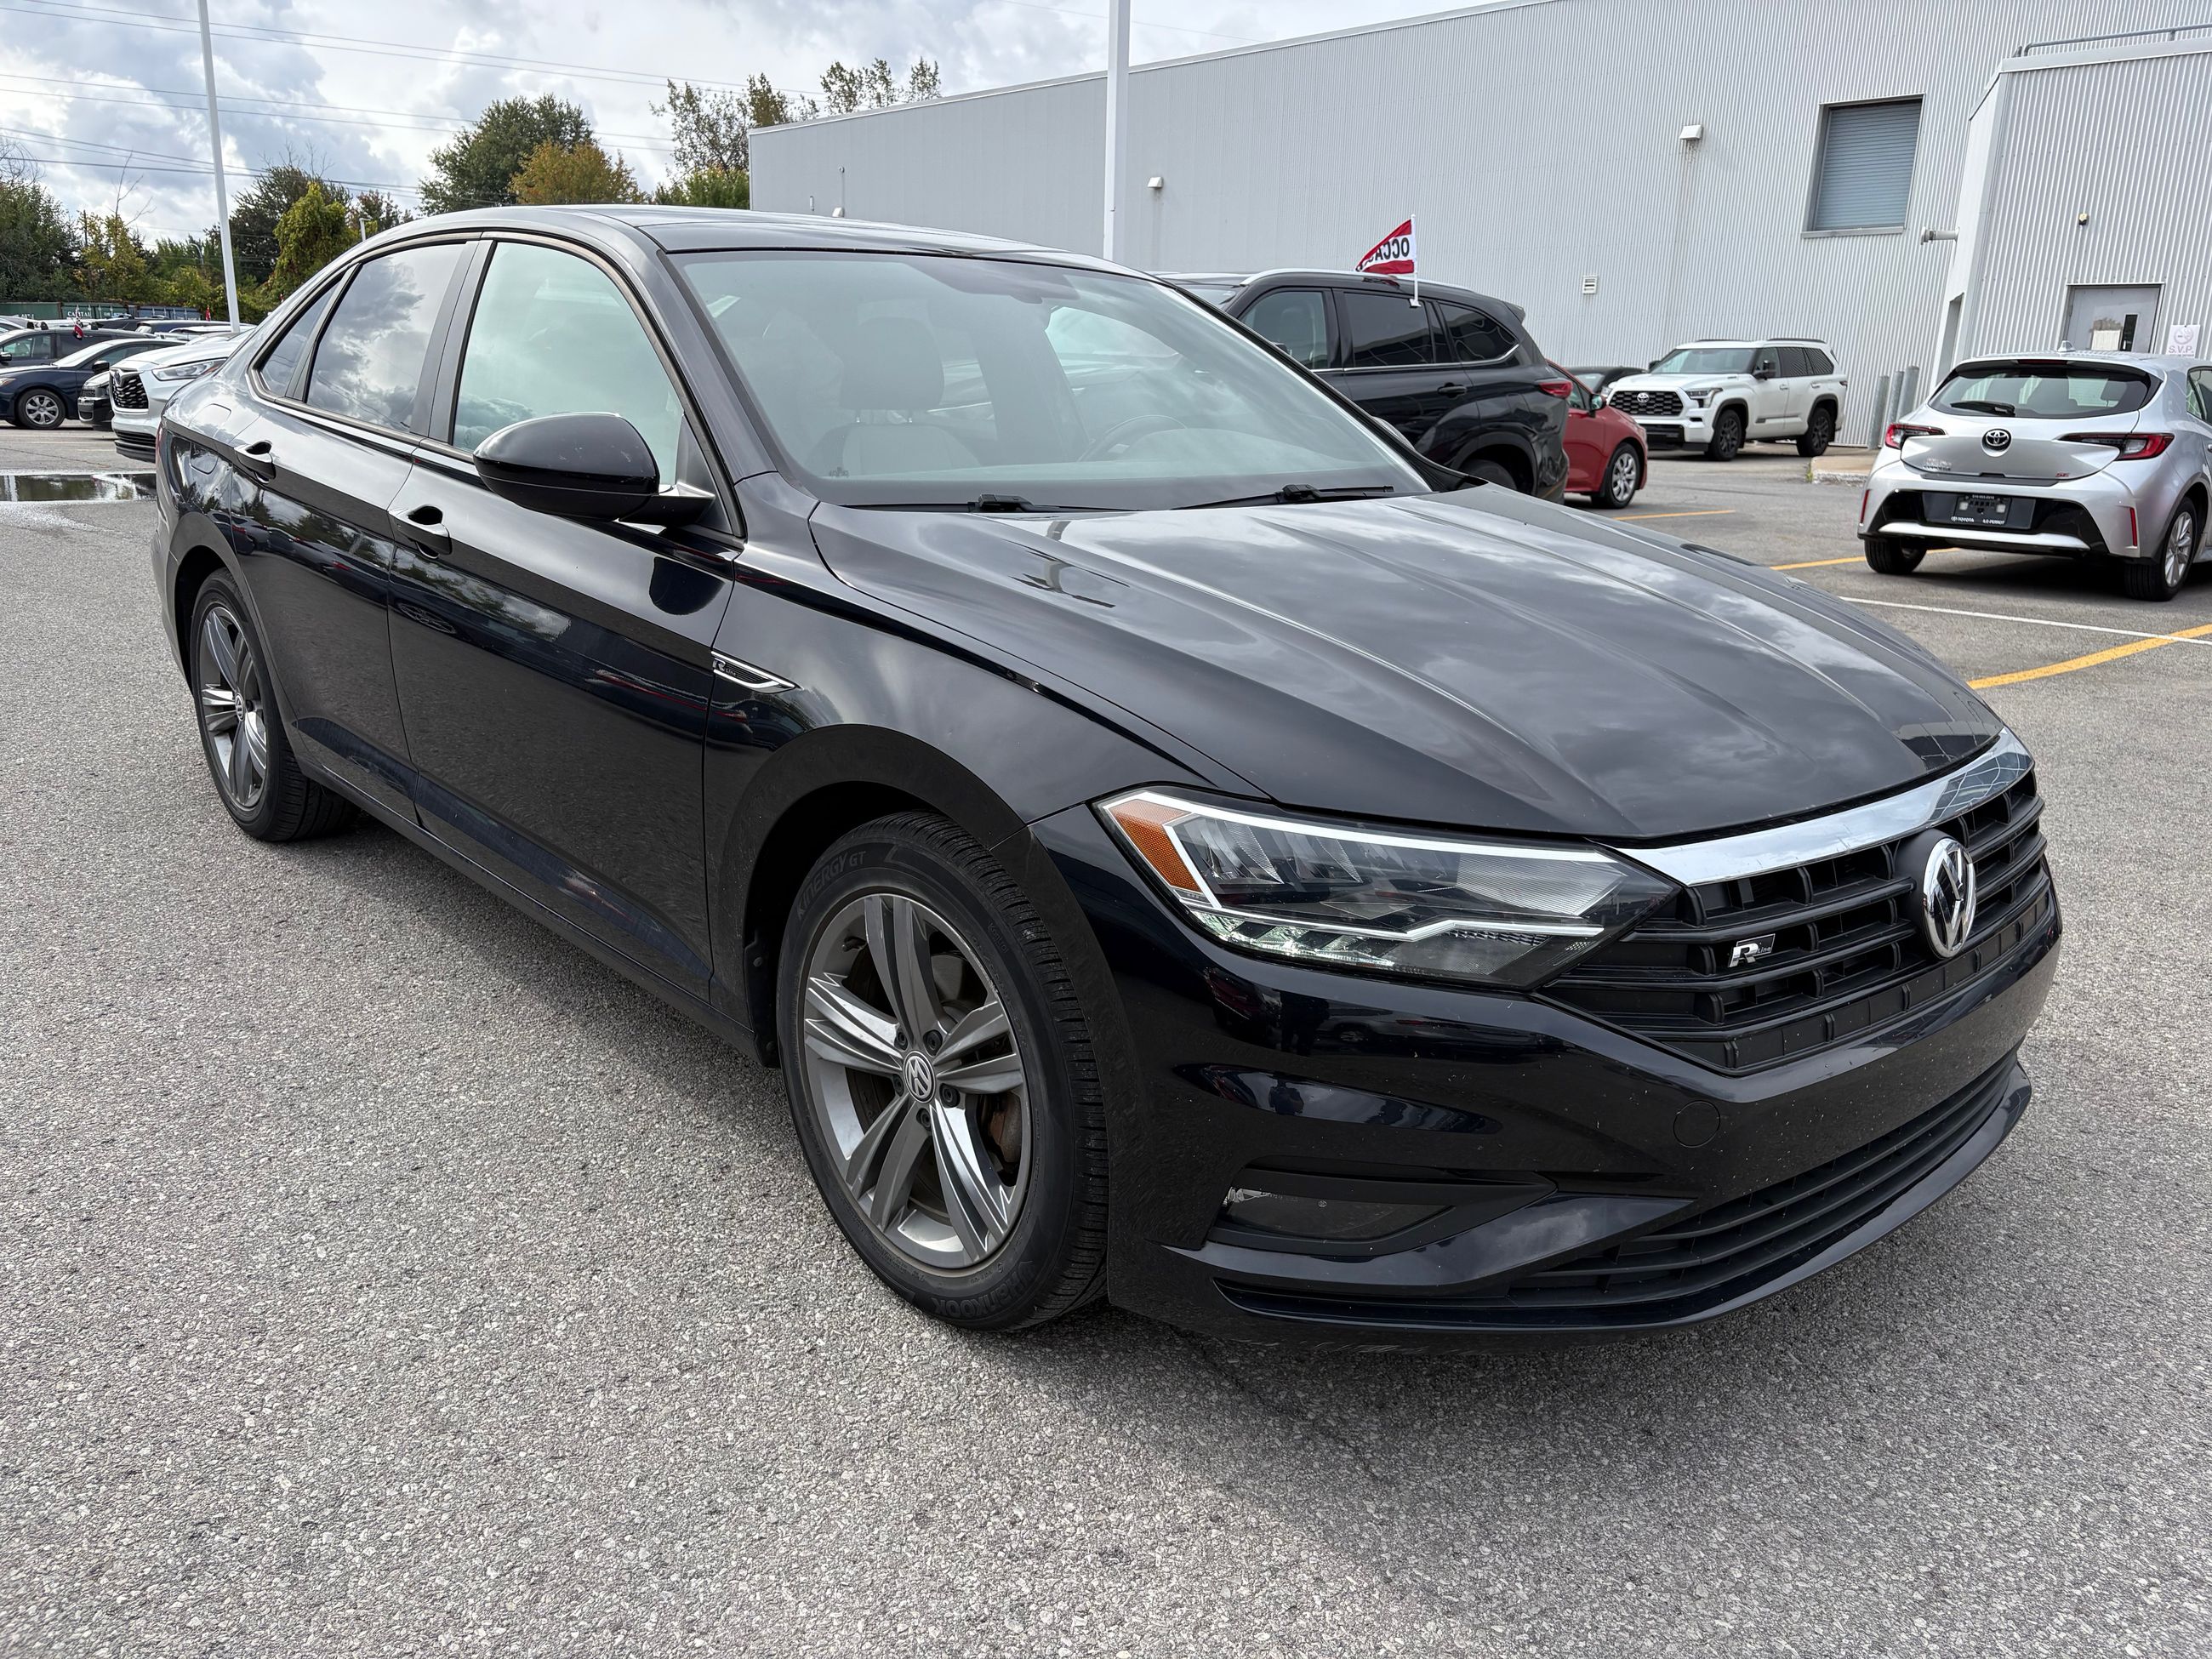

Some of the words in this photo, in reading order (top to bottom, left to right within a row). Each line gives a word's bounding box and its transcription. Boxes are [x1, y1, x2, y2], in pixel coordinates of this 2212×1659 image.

[2169, 345, 2194, 354] S.V.P.
[849, 851, 866, 867] GT
[1730, 943, 1759, 967] R
